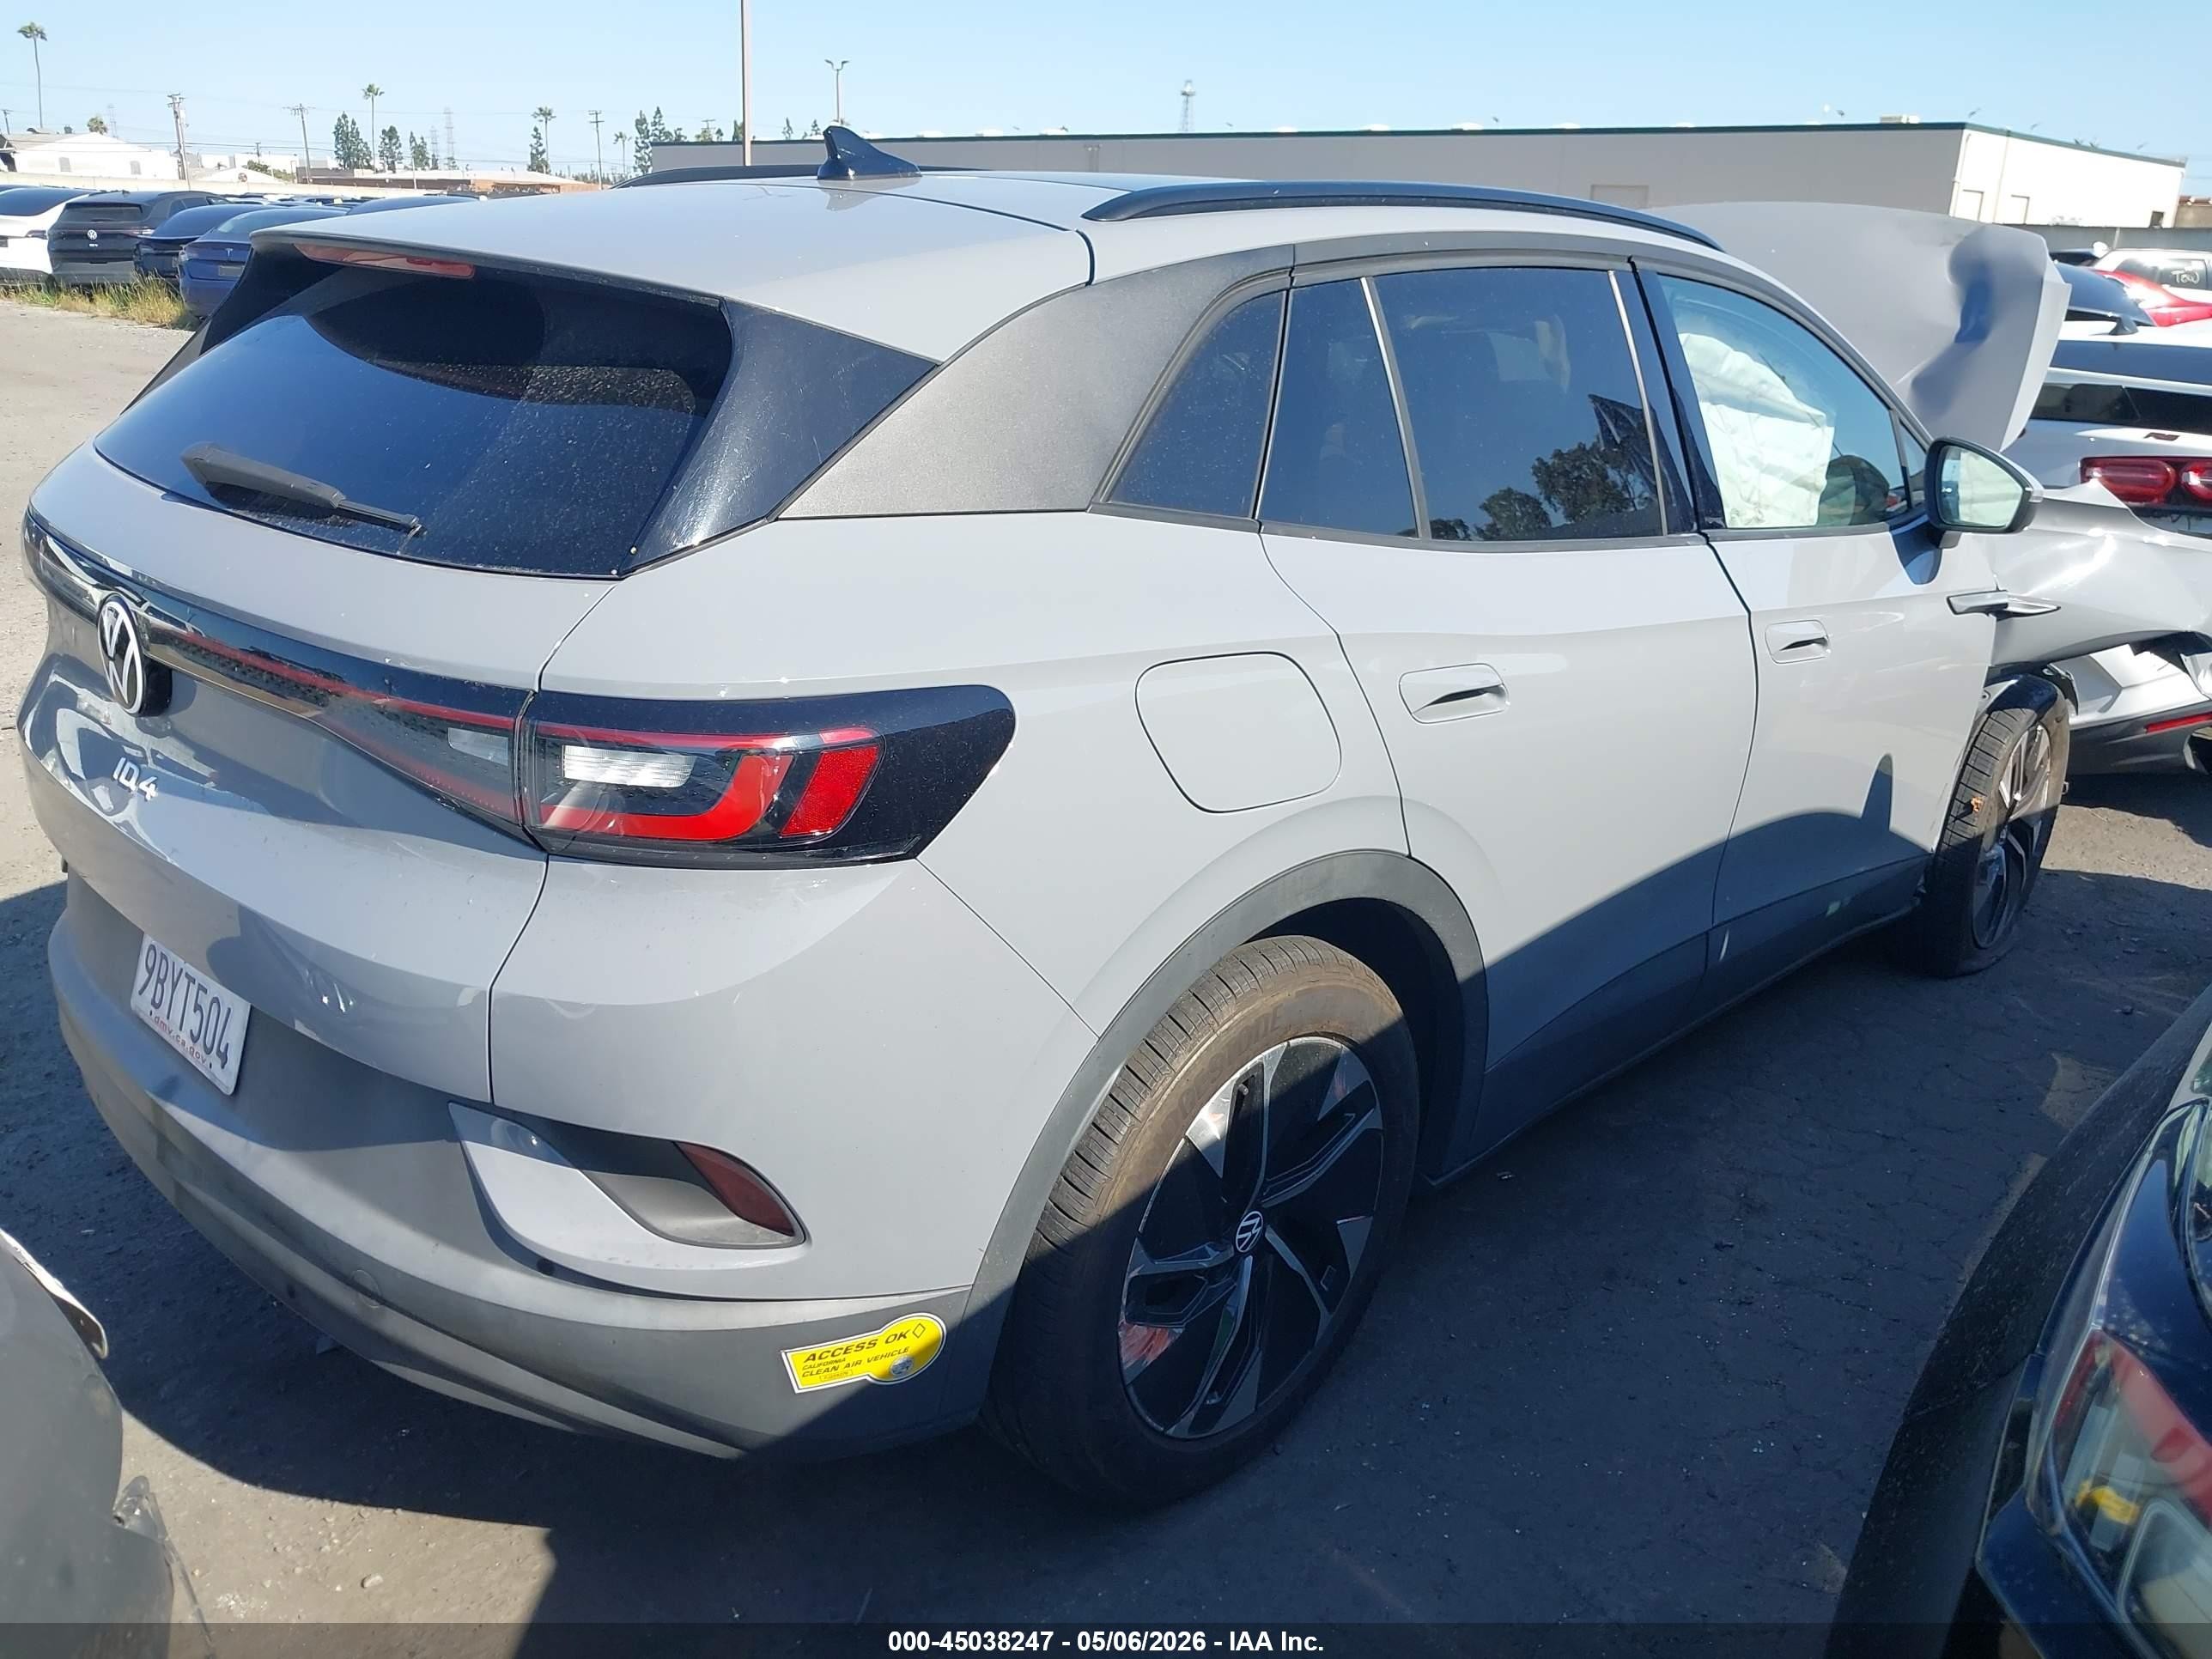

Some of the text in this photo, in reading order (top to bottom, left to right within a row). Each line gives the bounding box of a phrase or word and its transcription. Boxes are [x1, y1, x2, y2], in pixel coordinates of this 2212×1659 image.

[138, 944, 232, 1070] 9BYT504
[802, 1365, 840, 1378] CLEAN
[843, 1359, 862, 1370] AIR
[866, 1346, 910, 1363] VEHICLE
[804, 1329, 910, 1364] ACCESS OK
